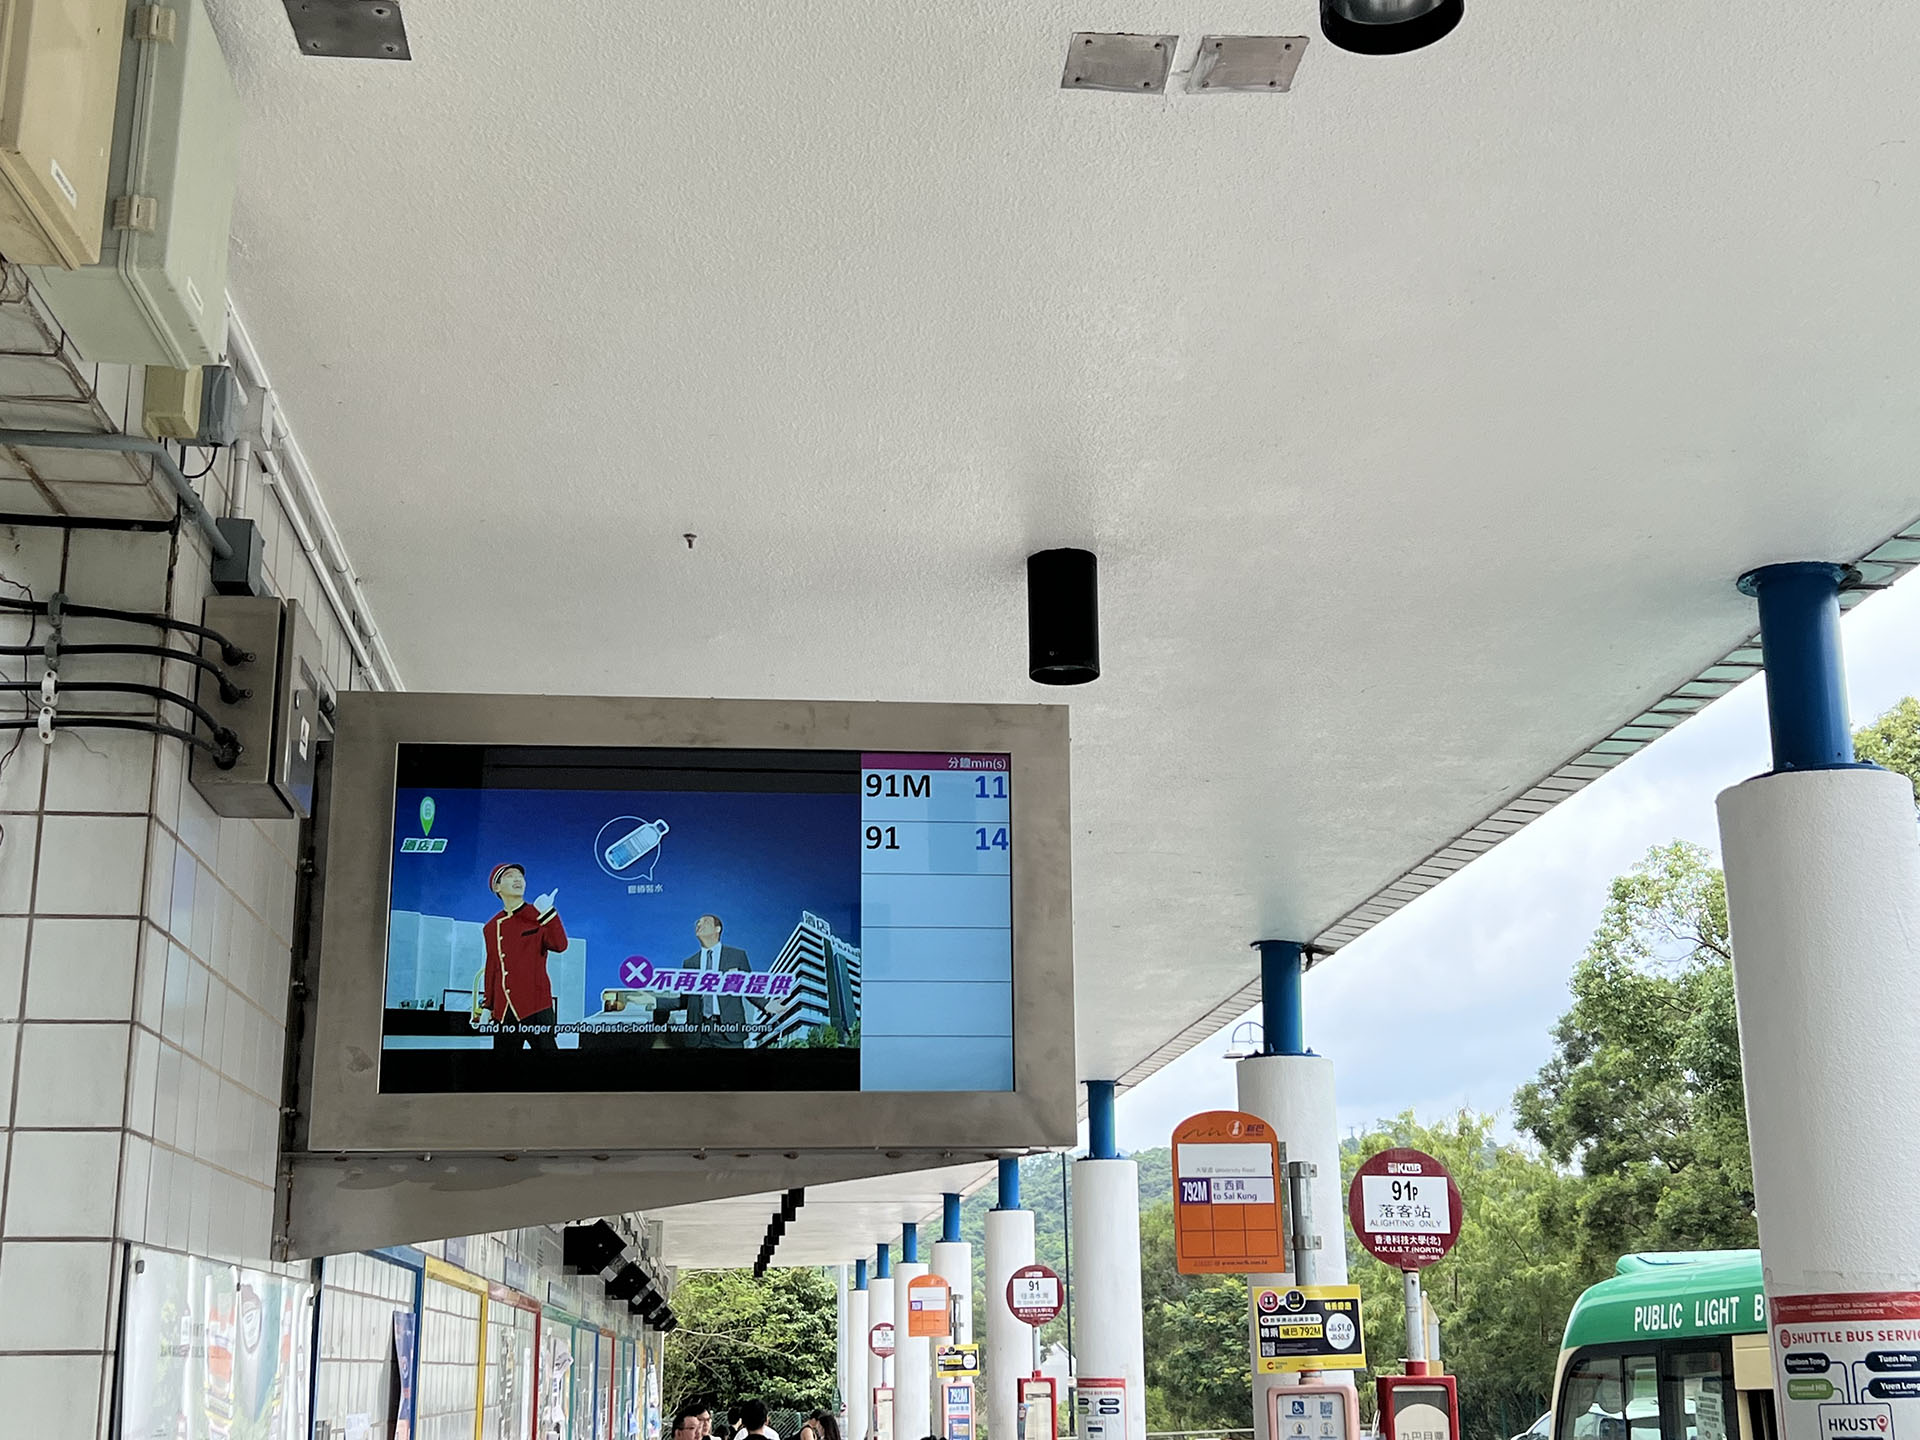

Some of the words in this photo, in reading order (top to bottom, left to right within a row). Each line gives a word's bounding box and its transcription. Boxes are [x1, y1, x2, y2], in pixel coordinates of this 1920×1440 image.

[865, 774, 931, 798] 91M
[975, 776, 1007, 798] 11
[865, 826, 900, 850] 91
[975, 828, 1009, 850] 14
[652, 970, 793, 995] 不再免費提供
[480, 1023, 499, 1033] and
[502, 1025, 514, 1033] no
[518, 1023, 551, 1035] longer
[670, 1024, 698, 1033] water
[701, 1023, 711, 1033] in
[713, 1023, 739, 1033] hotel
[741, 1024, 773, 1033] rooms
[1182, 1181, 1208, 1202] 792M
[1224, 1180, 1245, 1191] 西貢
[1224, 1192, 1235, 1200] Sai
[1237, 1192, 1257, 1202] Kung
[1379, 1204, 1431, 1219] 落客站
[1370, 1219, 1415, 1227] ALIGHTING
[1419, 1220, 1442, 1228] ONLY
[1375, 1235, 1441, 1246] 香港科技大學(北)
[1028, 1280, 1040, 1291] 91
[1634, 1302, 1683, 1332] PUBLIC
[1695, 1296, 1740, 1327] LIGHT
[1299, 1327, 1321, 1336] 792M
[1337, 1323, 1352, 1332] $1.0
[1792, 1331, 1842, 1344] SHUTTLE
[1846, 1330, 1874, 1342] BUS
[1878, 1354, 1899, 1363] Tuen
[1899, 1354, 1918, 1362] Mun
[1880, 1382, 1901, 1390] Yuen
[1828, 1418, 1877, 1431] HKUST
